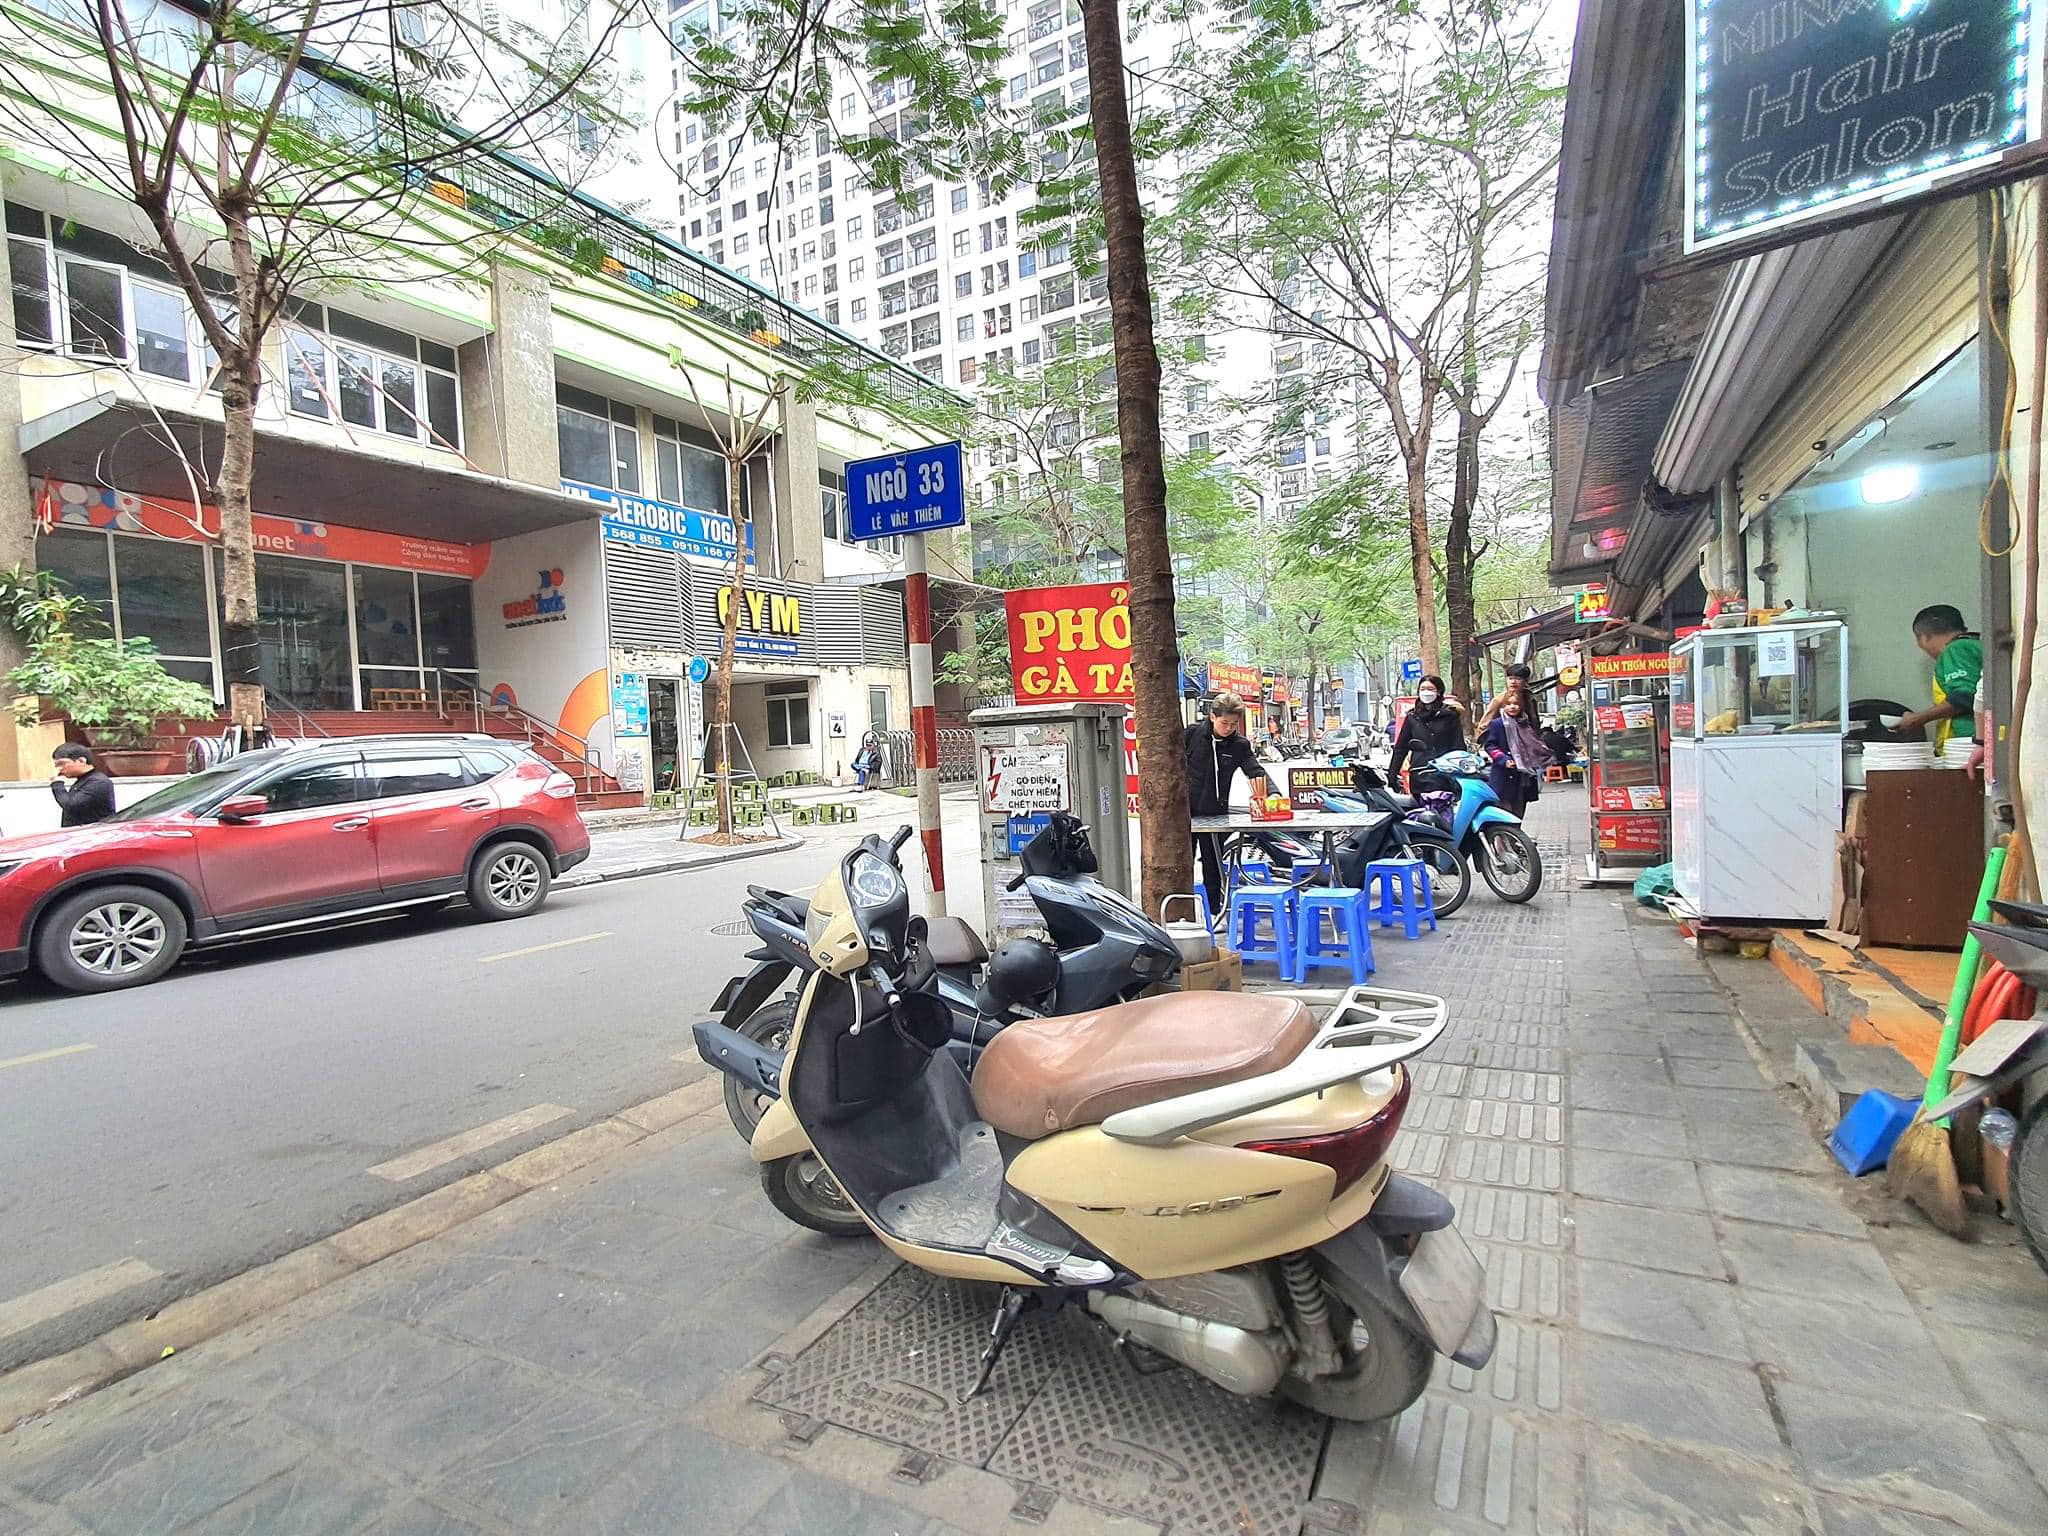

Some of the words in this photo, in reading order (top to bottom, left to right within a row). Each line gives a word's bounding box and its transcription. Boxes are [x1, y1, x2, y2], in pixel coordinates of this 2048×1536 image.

[1742, 21, 1970, 142] Hair
[918, 461, 945, 495] 33
[609, 496, 687, 536] AEROBIC
[611, 527, 635, 540] 568
[639, 533, 662, 546] 855
[672, 540, 700, 553] 0919
[1021, 657, 1080, 696] GÀ
[1293, 771, 1315, 785] CAFE
